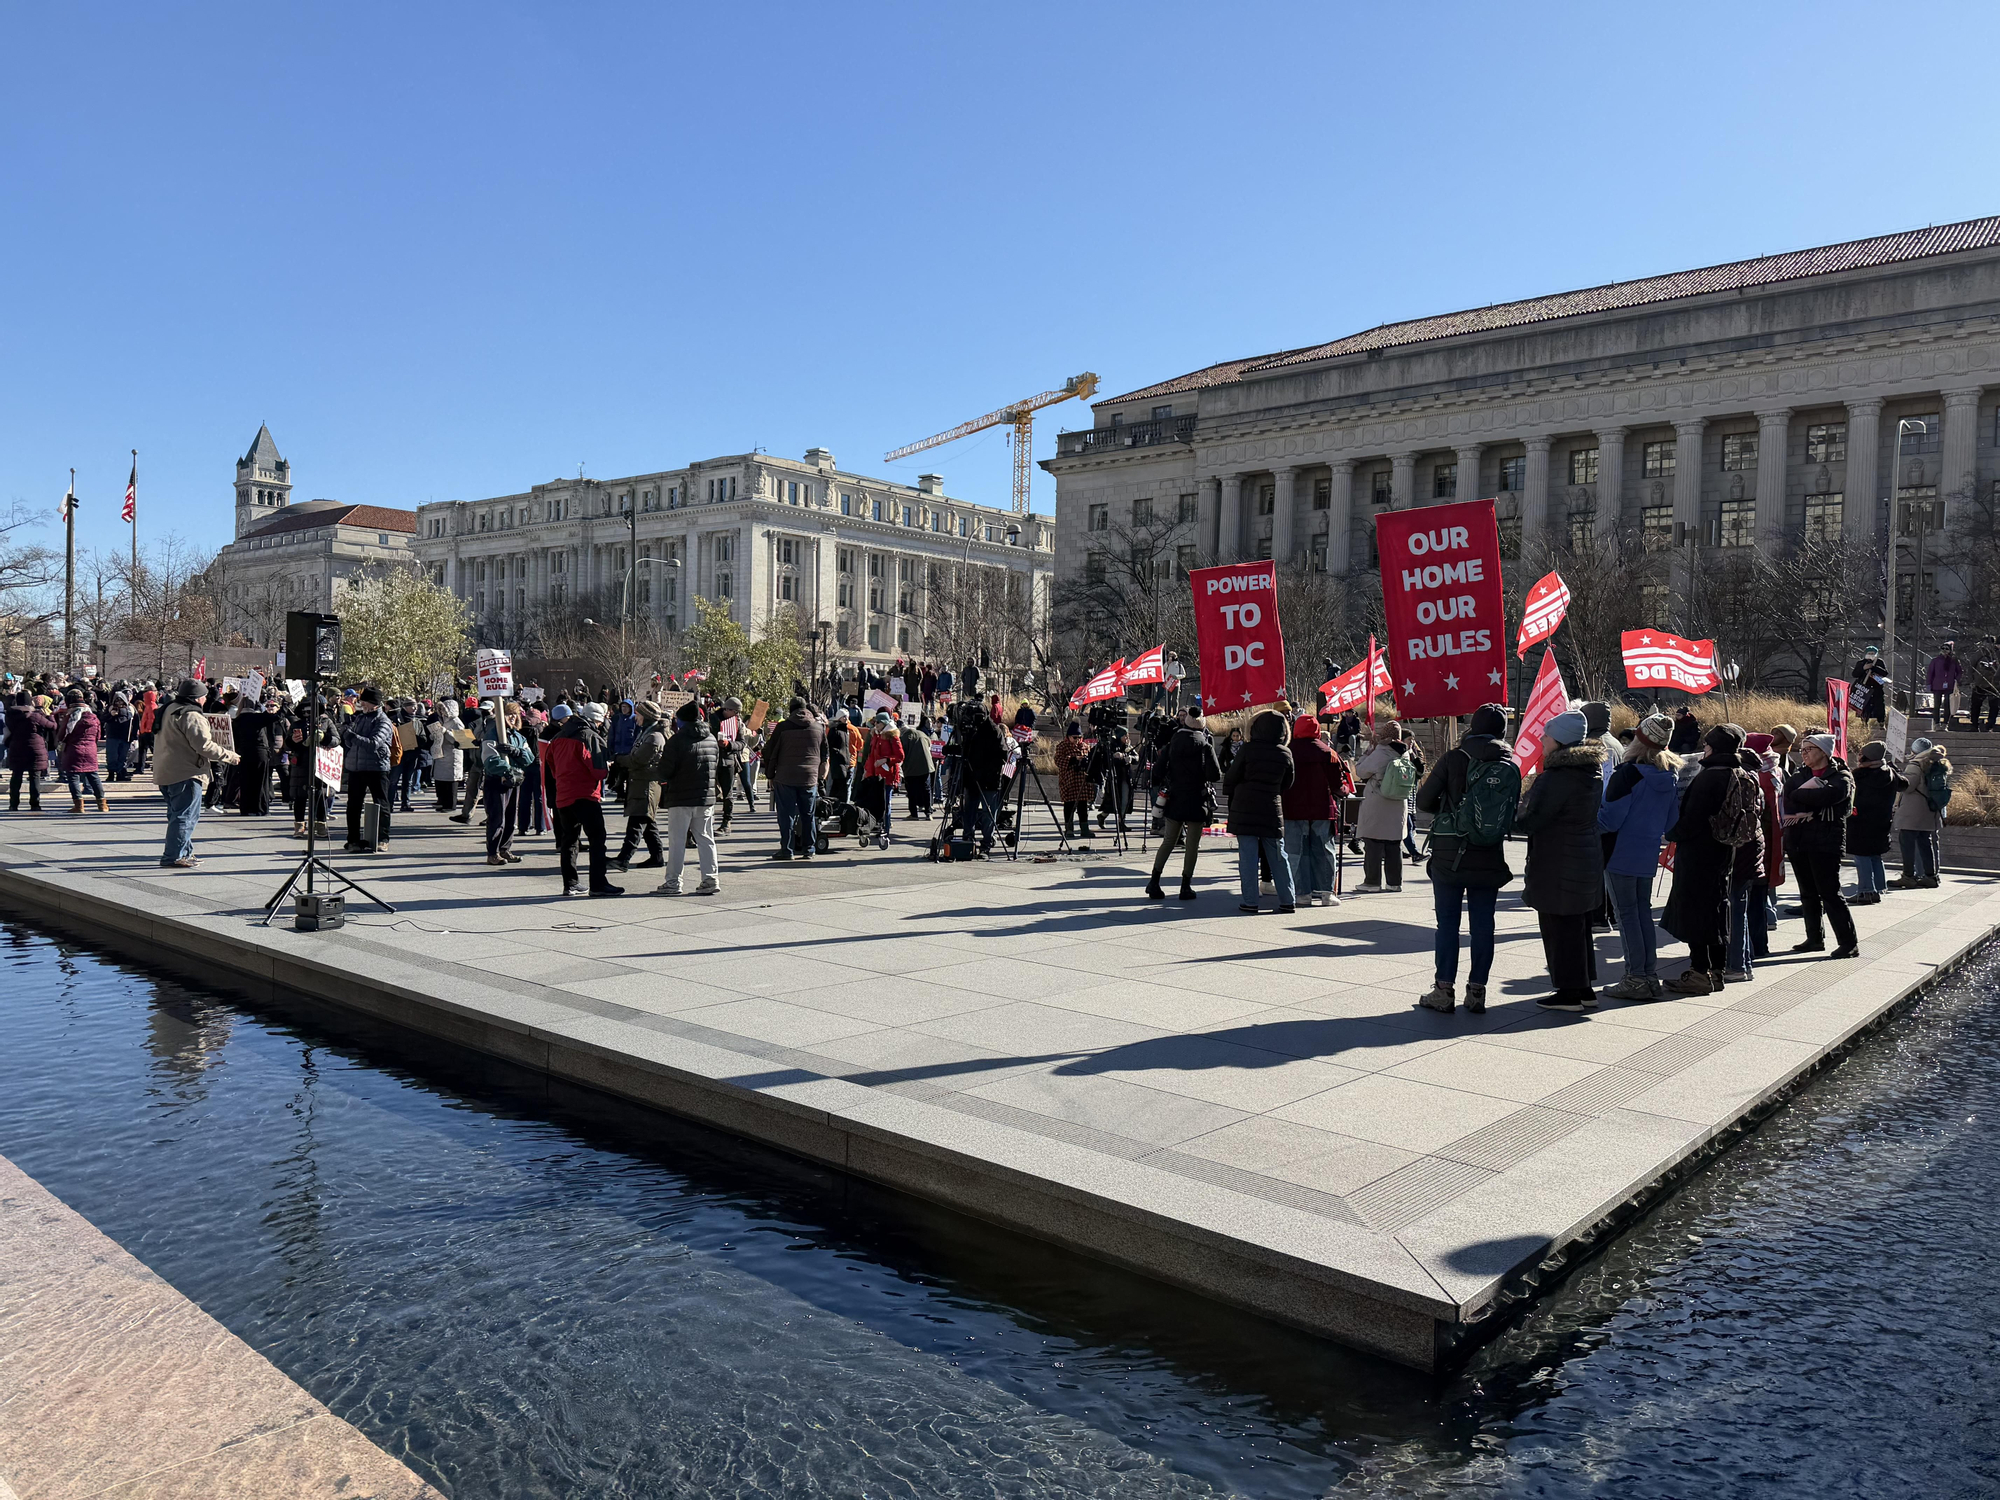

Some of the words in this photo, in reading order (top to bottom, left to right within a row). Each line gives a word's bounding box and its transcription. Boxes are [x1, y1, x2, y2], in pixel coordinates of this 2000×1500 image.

[1408, 526, 1469, 555] OUR
[1207, 574, 1271, 596] POWER
[1402, 558, 1484, 592] HOME
[1220, 603, 1262, 630] TO
[1416, 595, 1476, 625] OUR
[1224, 641, 1265, 671] DC
[1407, 629, 1492, 661] RULES
[480, 658, 510, 668] PROTECT
[489, 666, 501, 674] DC
[484, 676, 508, 684] HOME
